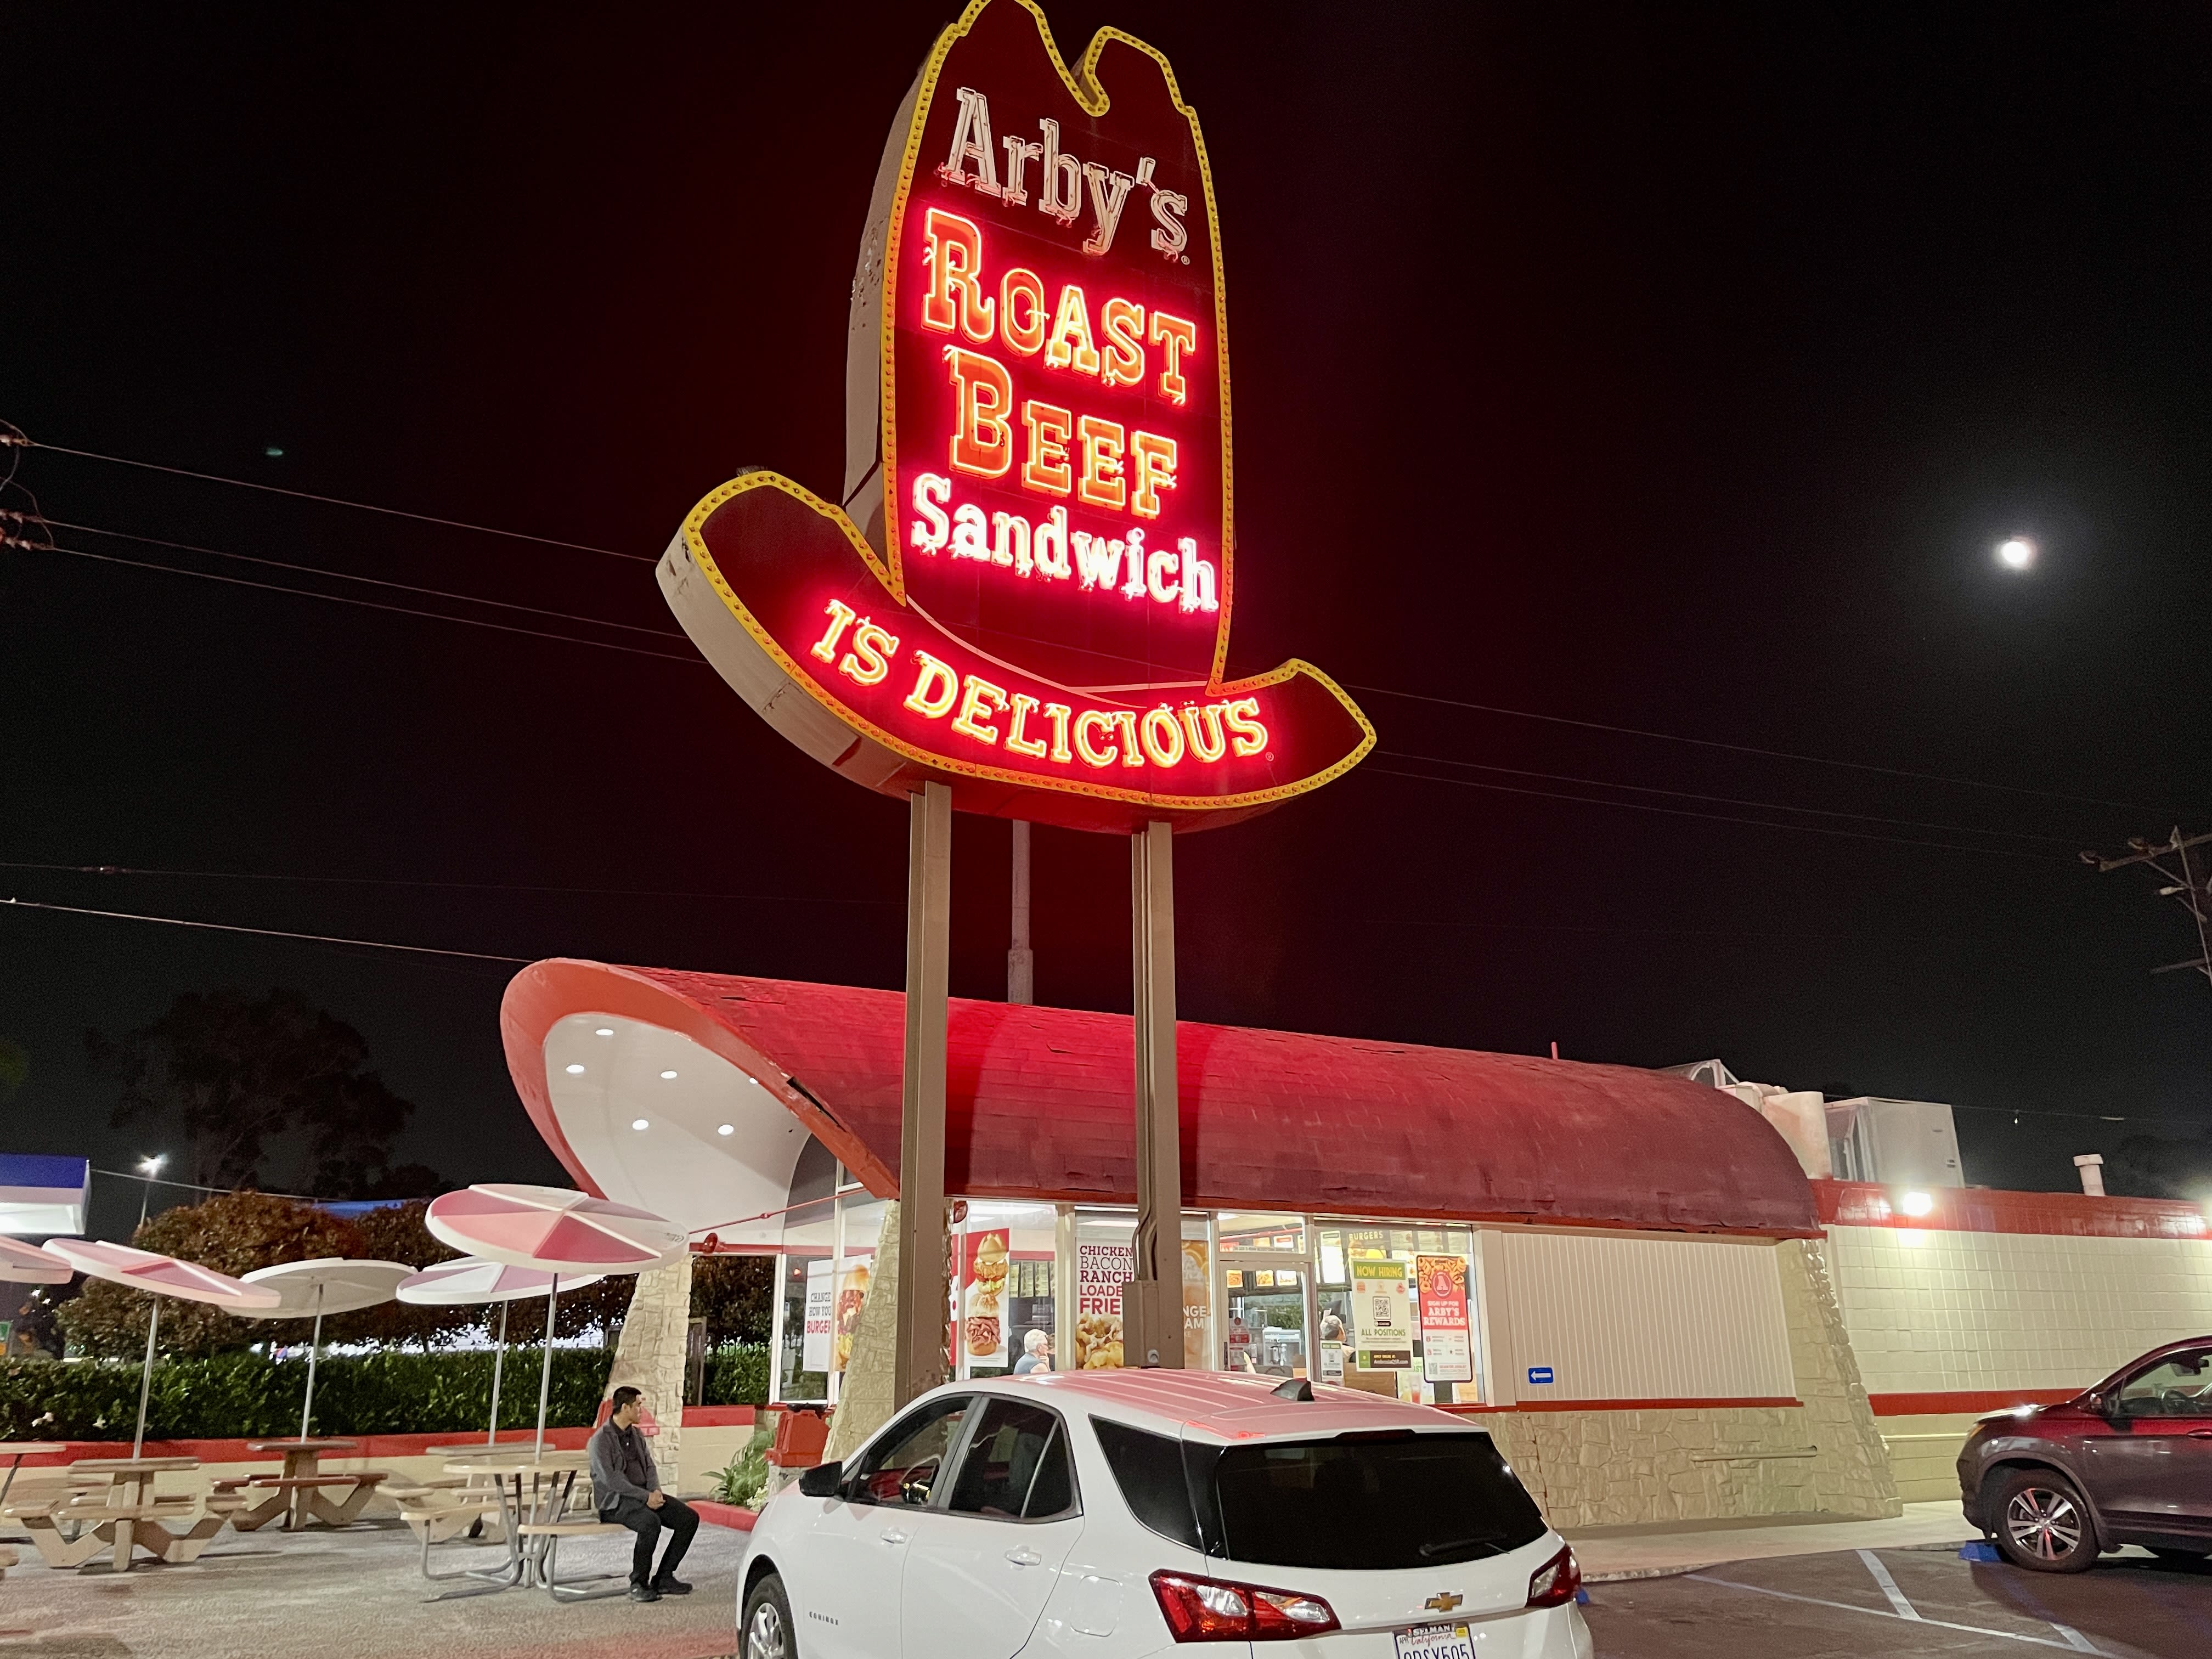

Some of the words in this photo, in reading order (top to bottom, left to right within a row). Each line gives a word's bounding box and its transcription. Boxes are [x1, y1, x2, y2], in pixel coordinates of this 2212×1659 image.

[940, 87, 1187, 257] Arby's
[921, 207, 1195, 403] ROAST
[946, 345, 1177, 518] BEEF
[911, 472, 1218, 612] Sandwich
[810, 599, 899, 685] IS
[904, 650, 1268, 768] DELICIOUS
[1349, 1231, 1383, 1241] BURGERS
[1080, 1245, 1132, 1257] CHICKEN
[1080, 1256, 1133, 1271] BACON
[1080, 1270, 1133, 1283] RANCH
[1357, 1266, 1375, 1277] NOW
[1378, 1266, 1403, 1278] HIRING
[1080, 1284, 1123, 1297] LOADE
[1080, 1297, 1121, 1314] FRIE
[1428, 1307, 1459, 1317] ARBY'S
[1423, 1317, 1466, 1326] REWARDS
[1374, 1328, 1406, 1336] POSITIONS
[1411, 1633, 1457, 1647] California
